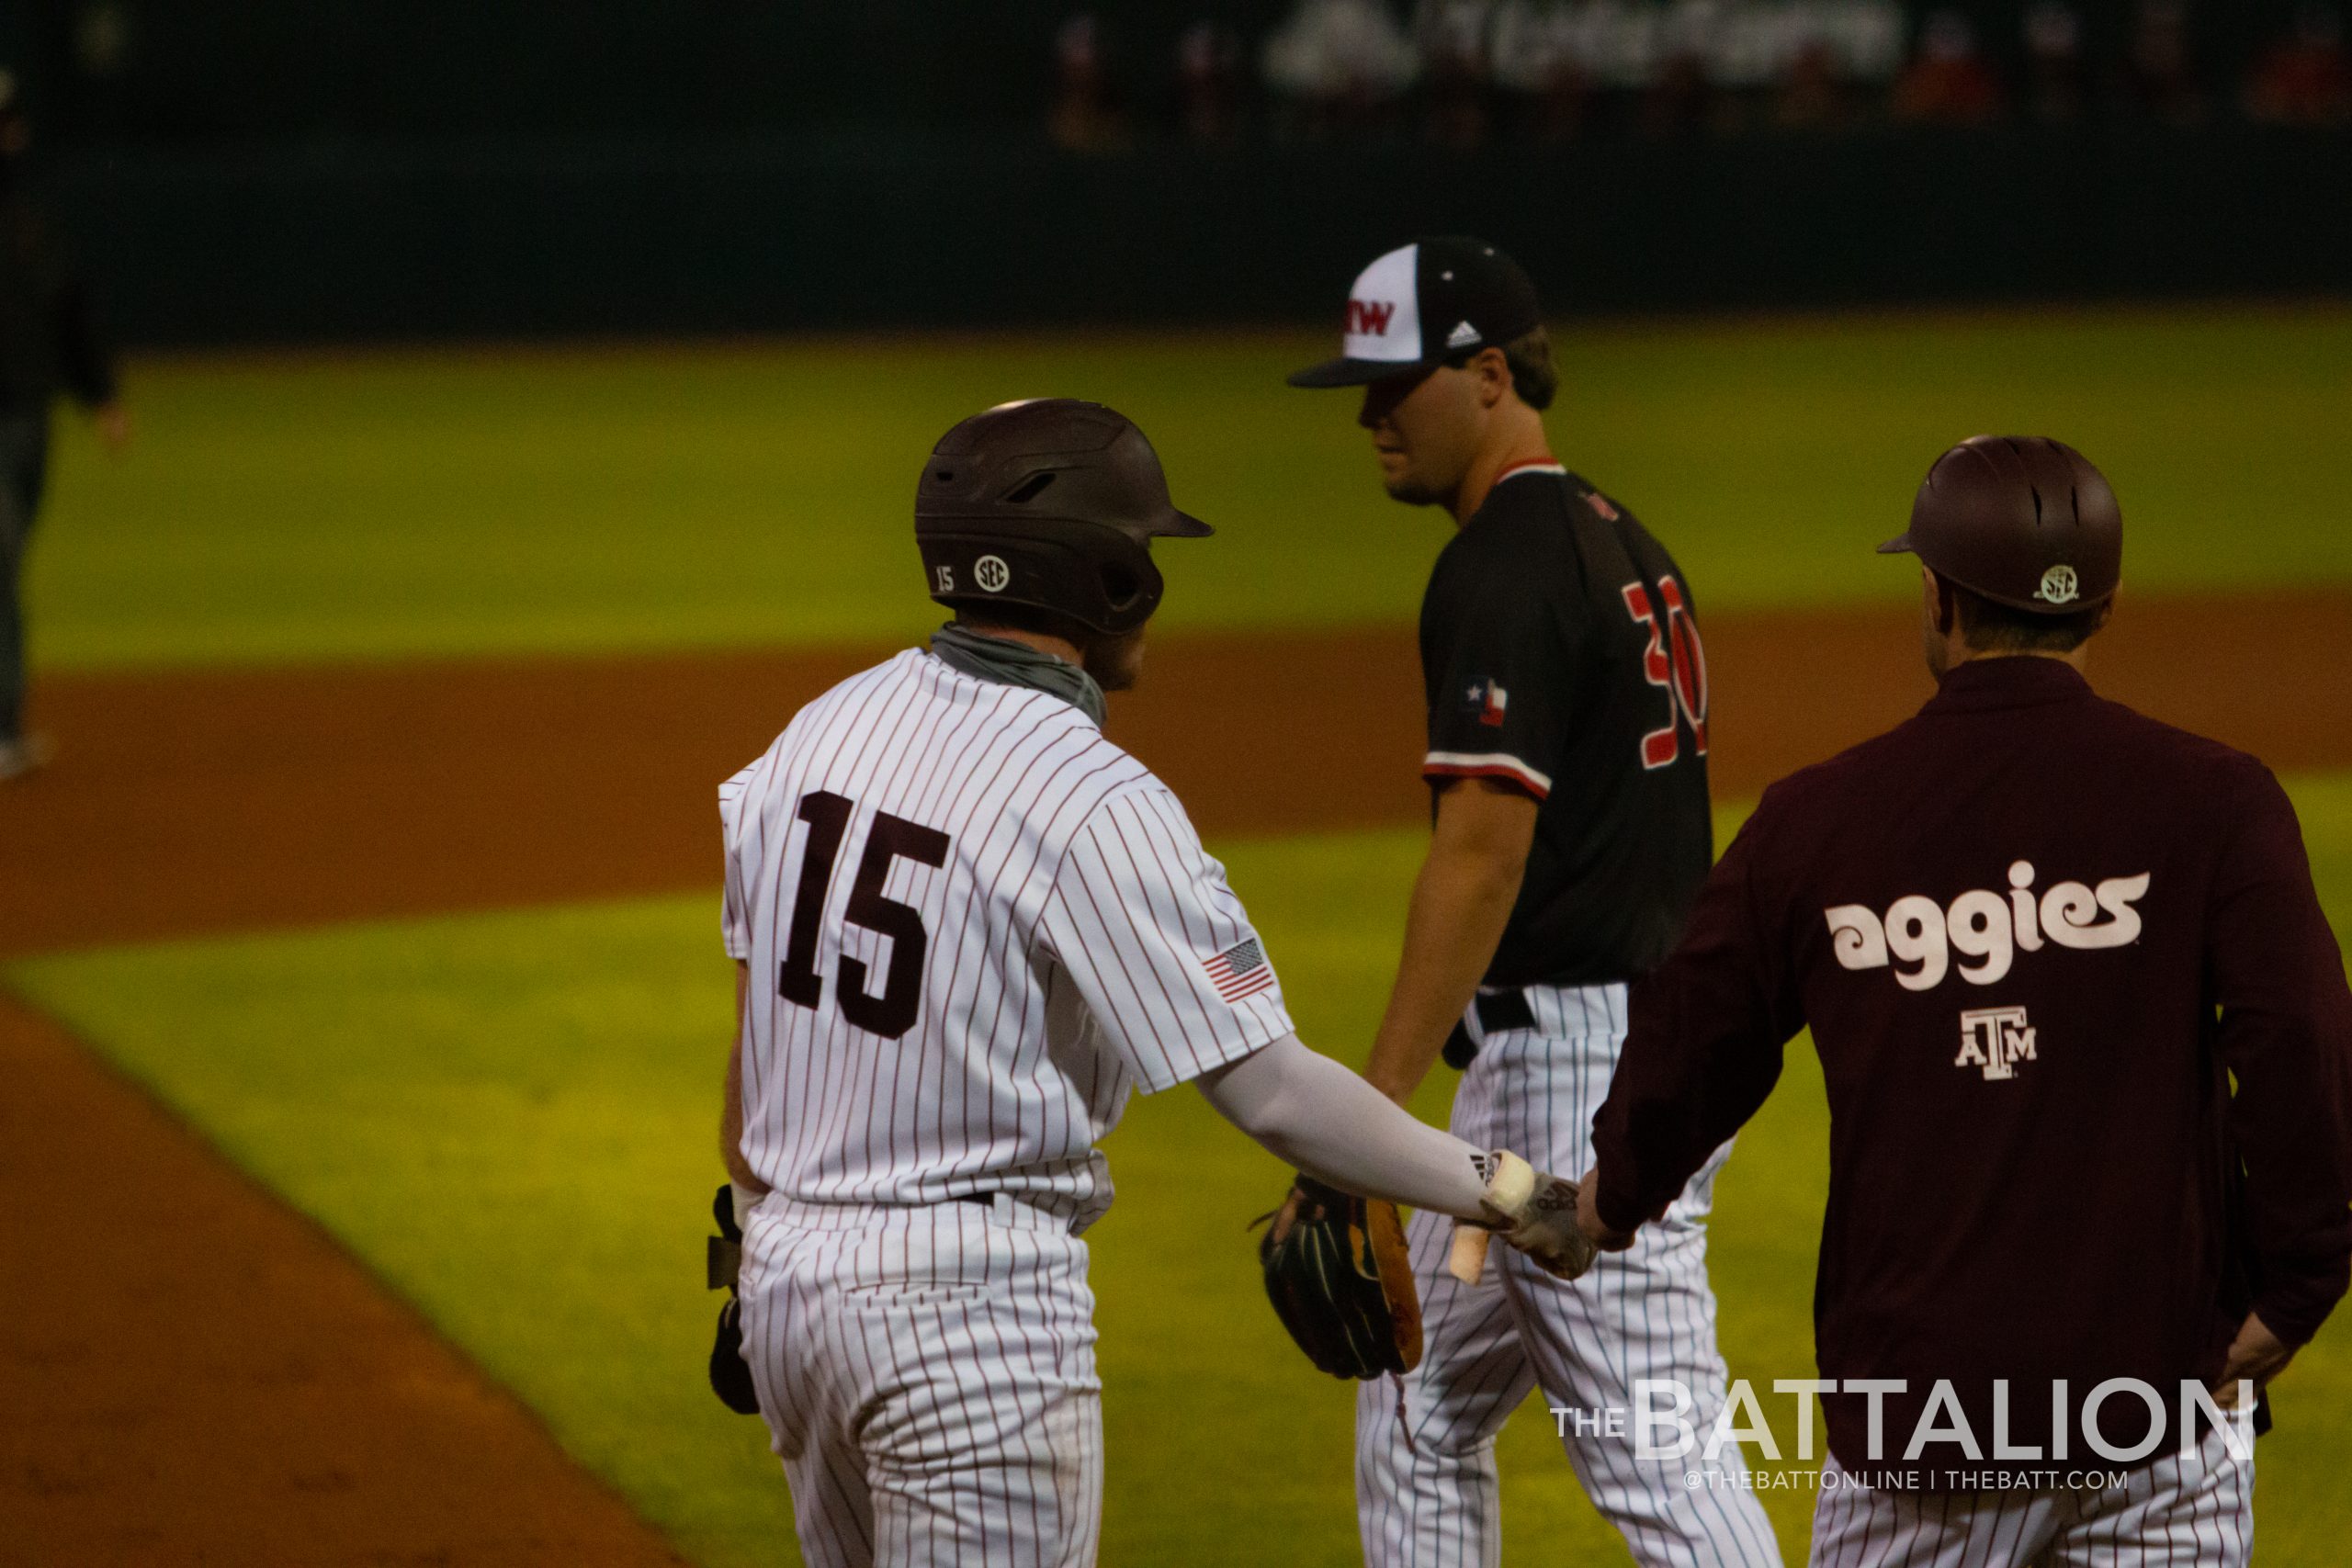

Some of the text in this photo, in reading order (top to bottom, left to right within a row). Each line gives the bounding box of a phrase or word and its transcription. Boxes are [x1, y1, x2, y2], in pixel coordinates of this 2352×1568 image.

[936, 565, 956, 592] 15
[978, 558, 1006, 589] SEC
[778, 790, 951, 1041] 15
[1824, 859, 2152, 992] aggies
